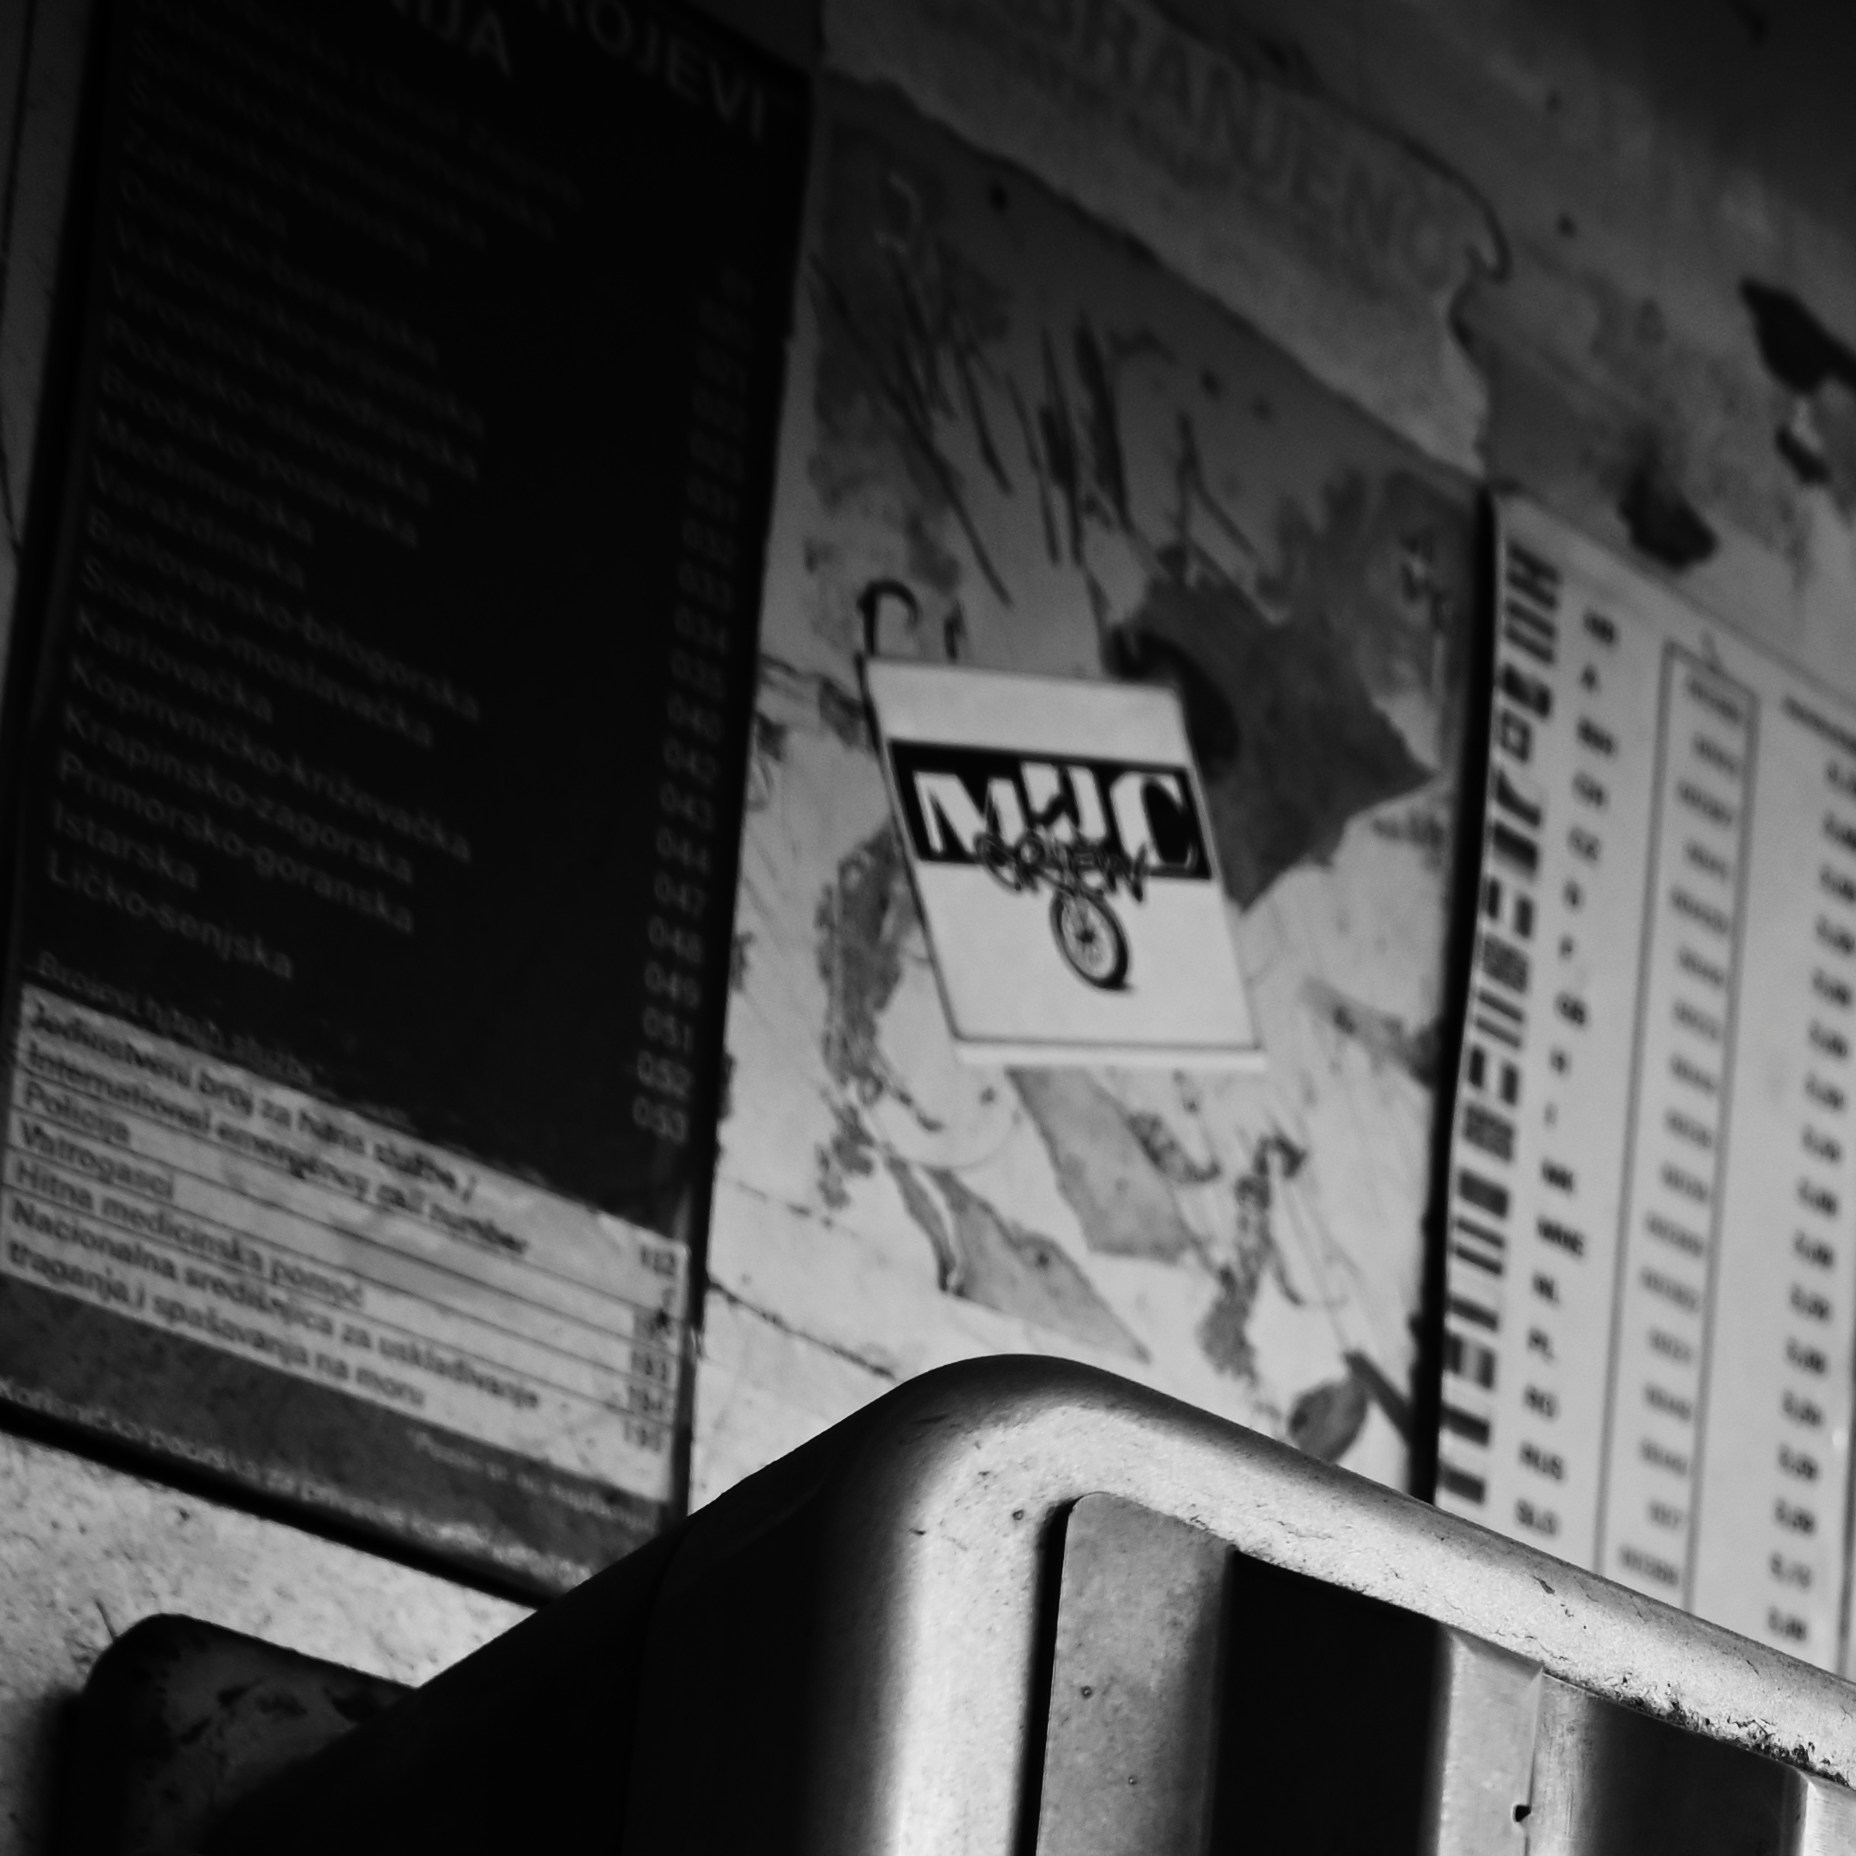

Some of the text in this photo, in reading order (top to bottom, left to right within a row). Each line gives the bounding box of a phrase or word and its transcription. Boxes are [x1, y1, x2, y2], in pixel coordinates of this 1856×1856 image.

[74, 606, 275, 725] Karlovačka
[62, 699, 414, 886] Krapinsko-zagorska
[69, 653, 473, 864] Koprivničko-križevačka
[51, 800, 199, 892] Istarska
[46, 848, 296, 982] Ličko-senjska
[57, 747, 695, 1056] Primorsko-goranska 051
[20, 1117, 175, 1202] Vatrogasci
[25, 1078, 132, 1149] Policija
[15, 1158, 94, 1211] Hitna
[11, 1198, 178, 1282] Nacionalna
